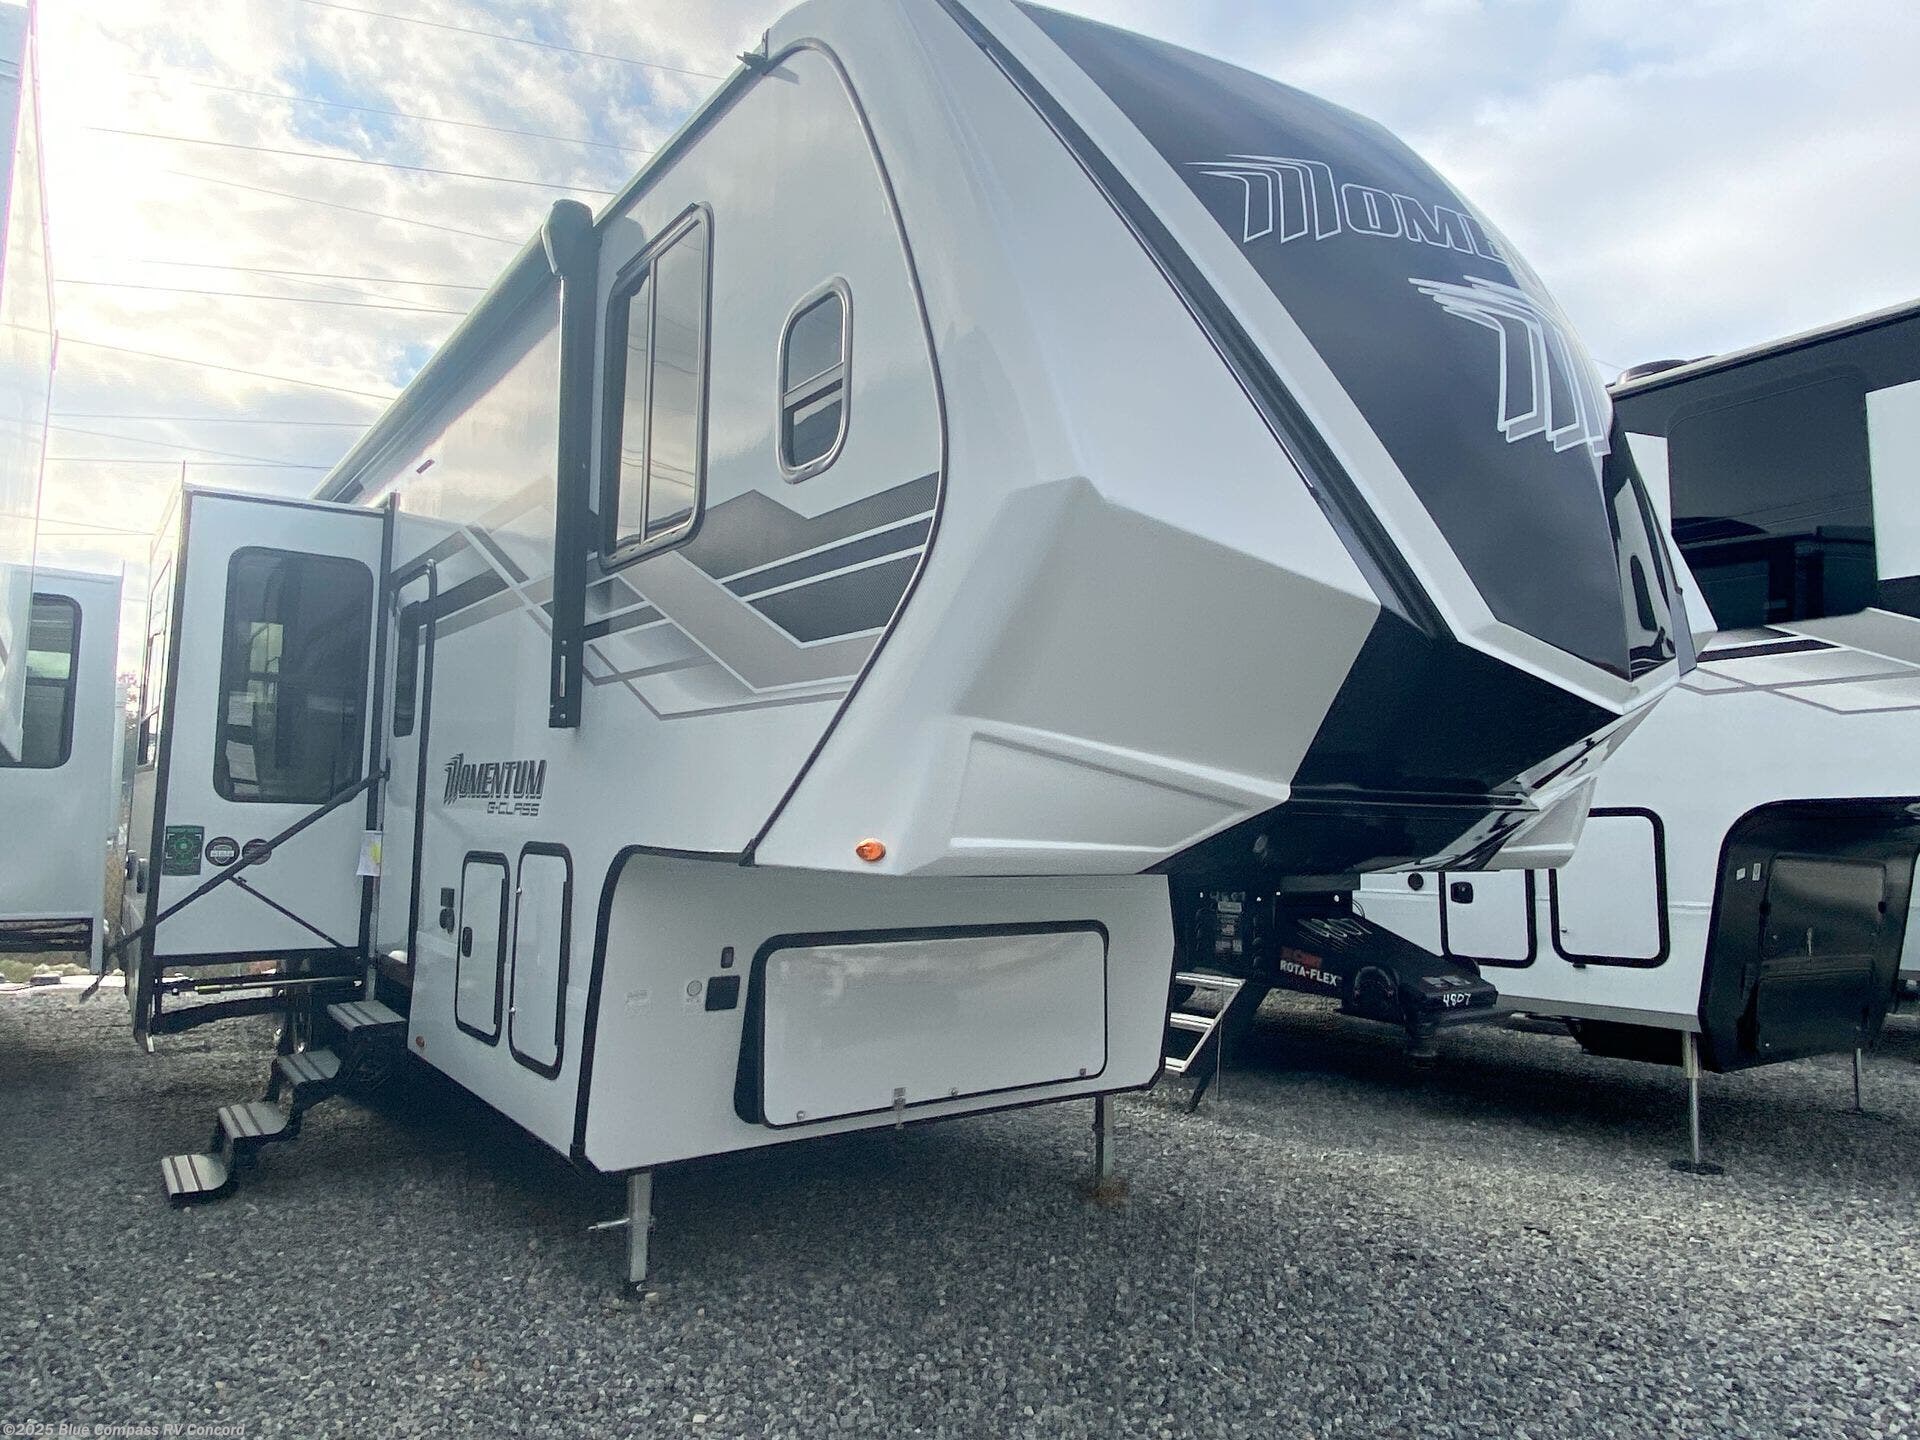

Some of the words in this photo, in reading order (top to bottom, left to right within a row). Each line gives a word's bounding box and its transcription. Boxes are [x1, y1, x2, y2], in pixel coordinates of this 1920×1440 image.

[443, 753, 547, 805] MOMENTUM
[487, 801, 541, 817] G-CLASS
[1279, 959, 1338, 987] ROTA-FLEX
